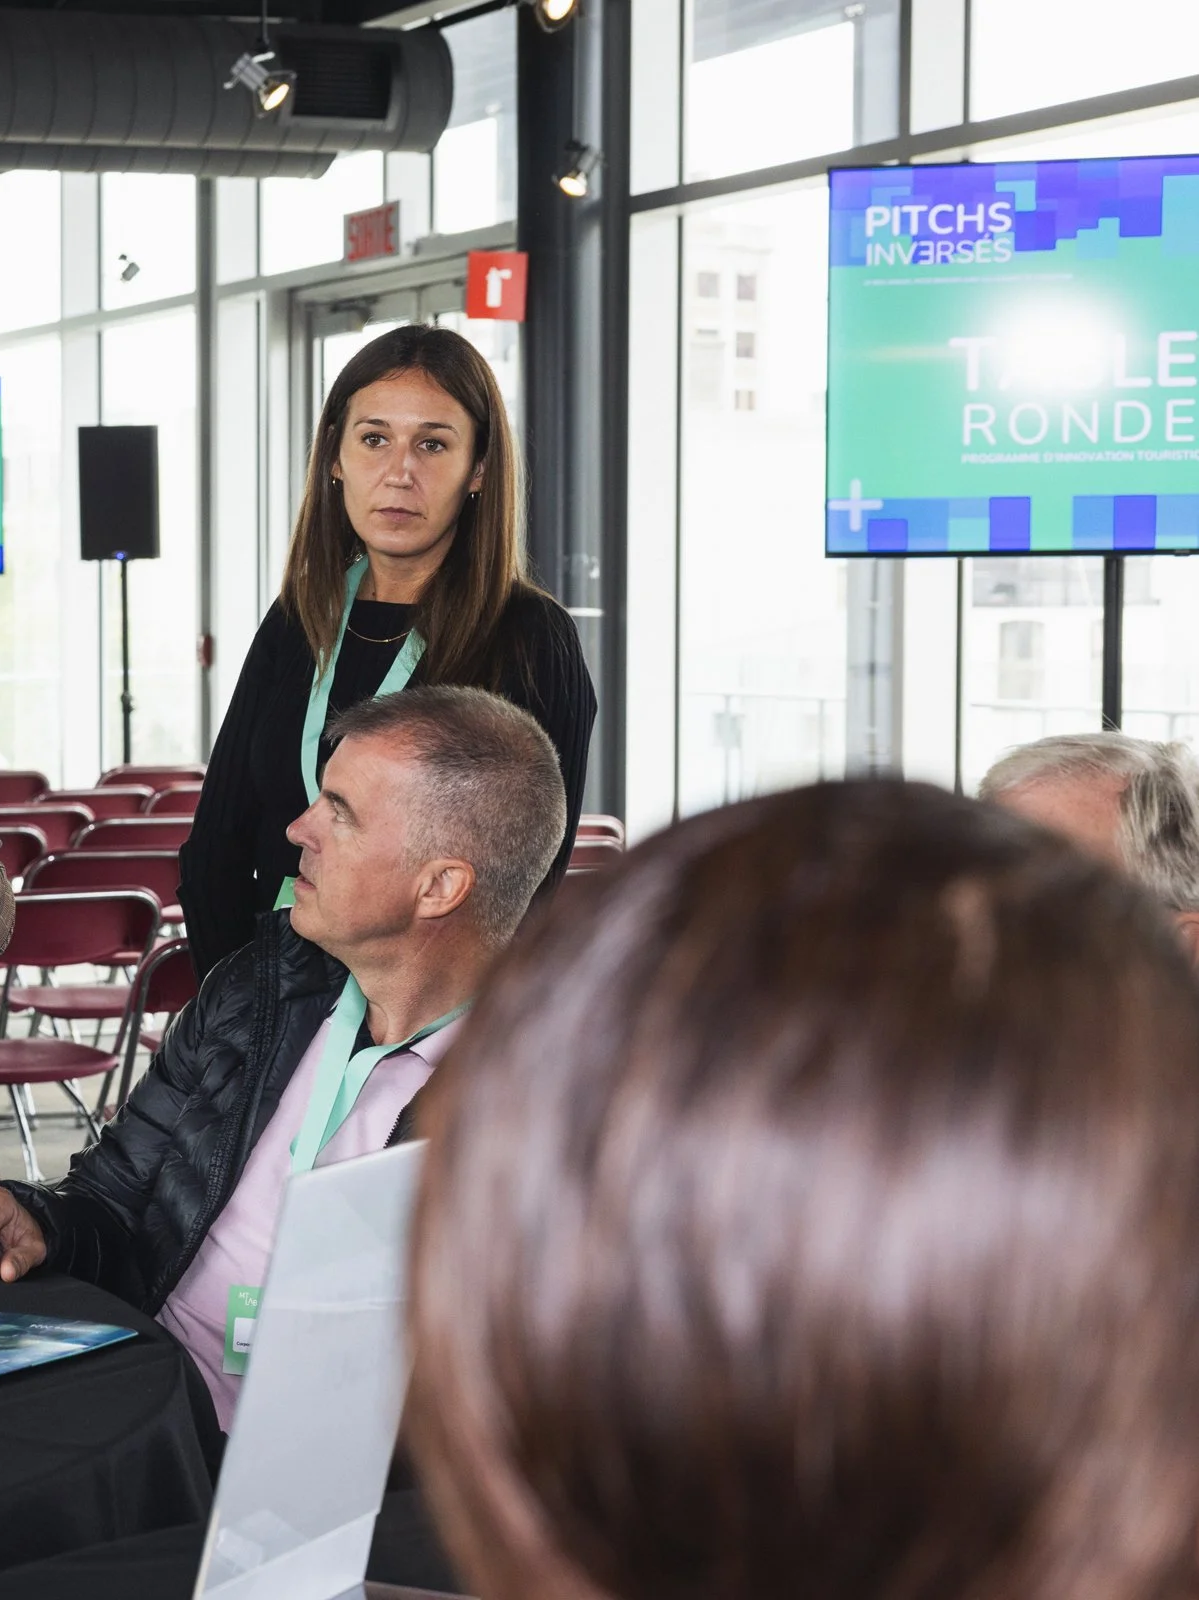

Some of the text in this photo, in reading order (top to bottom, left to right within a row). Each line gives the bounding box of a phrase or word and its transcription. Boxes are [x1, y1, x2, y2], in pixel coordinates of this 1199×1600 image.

[865, 202, 1012, 237] PITCHS
[948, 331, 1198, 392] TLE
[962, 398, 1195, 447] RONDE
[961, 452, 1040, 465] PROGRAMME
[1043, 451, 1134, 463] D'INNOVATION
